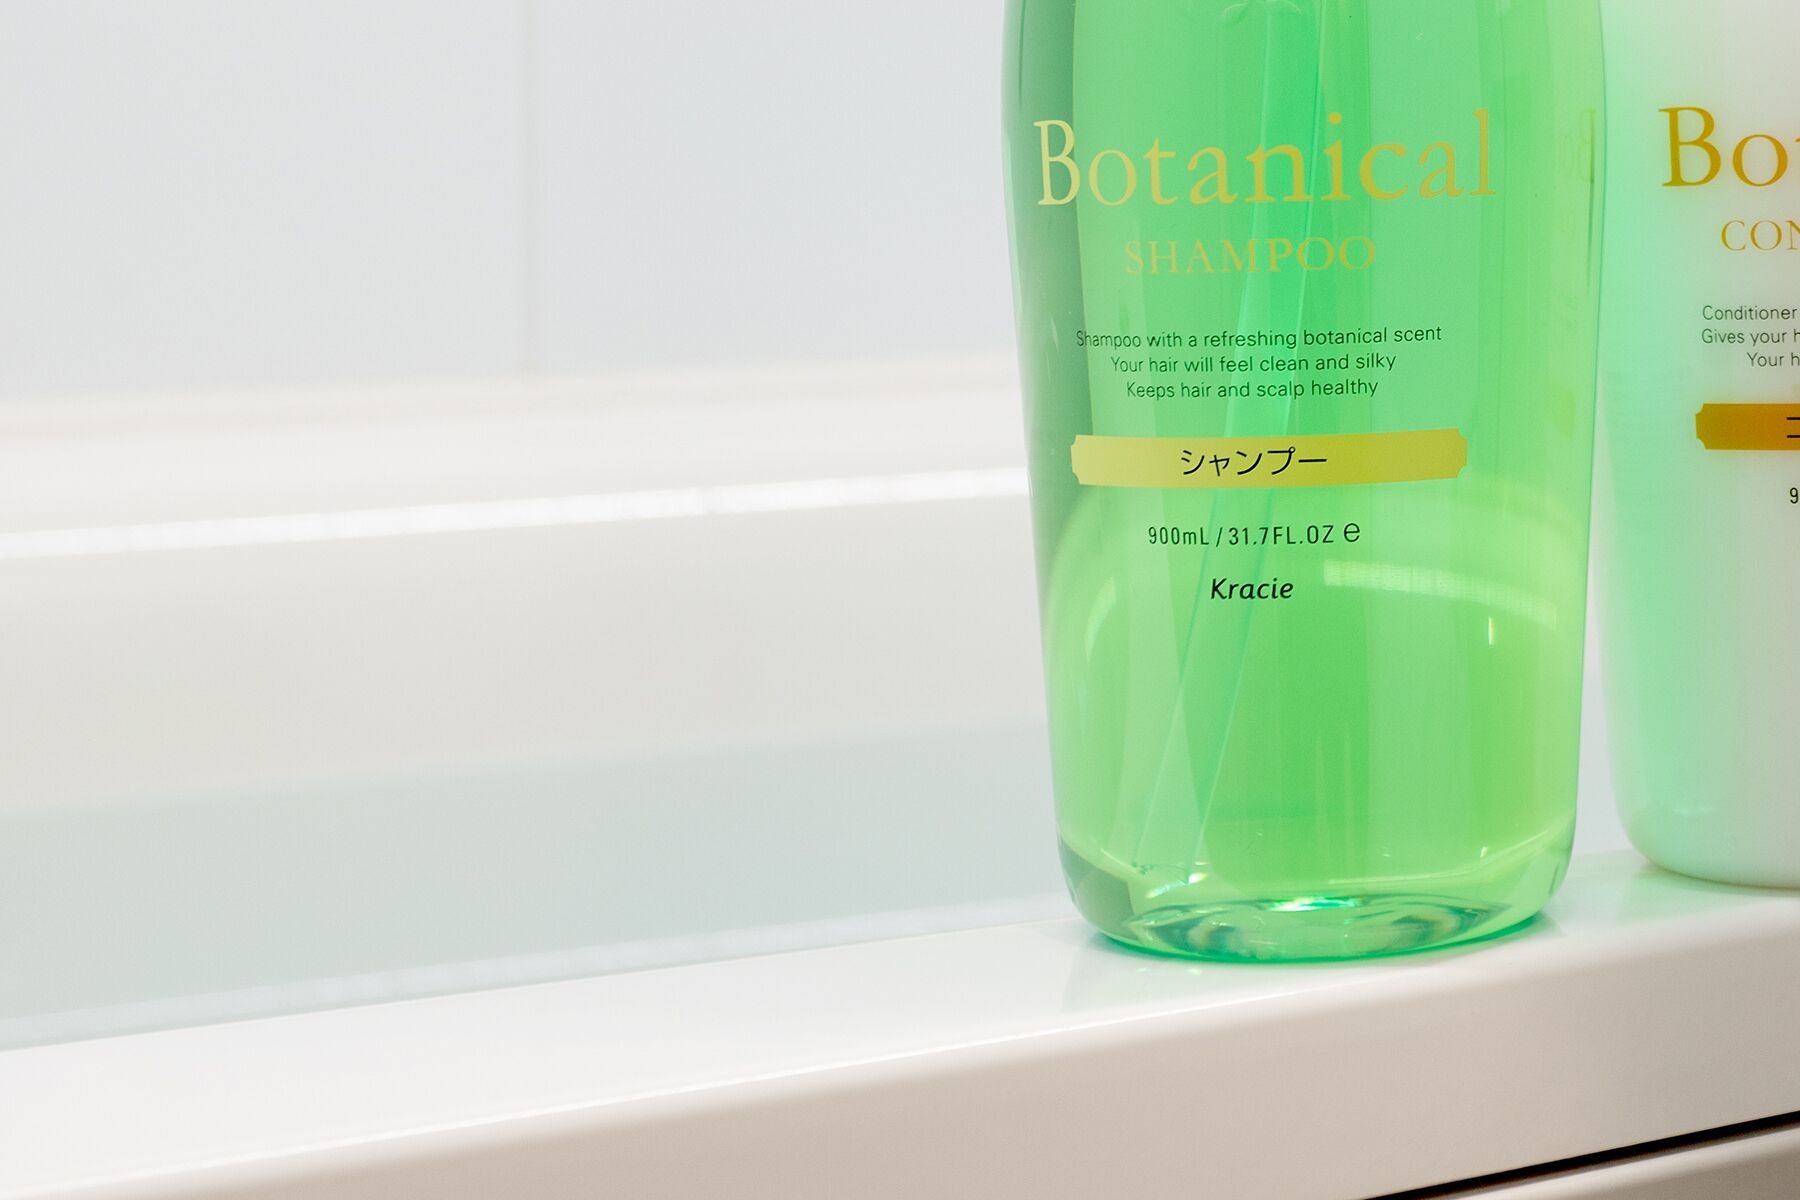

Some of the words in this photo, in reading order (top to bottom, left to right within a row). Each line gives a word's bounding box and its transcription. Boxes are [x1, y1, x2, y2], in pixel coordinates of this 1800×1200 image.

[1033, 107, 1496, 206] Botanical
[1125, 235, 1375, 275] SHAMPOO
[1702, 305, 1797, 321] Conditioner
[1076, 330, 1141, 348] Shampoo
[1147, 330, 1182, 346] with
[1188, 334, 1197, 346] a
[1204, 329, 1297, 349] refreshing
[1303, 327, 1387, 346] botanical
[1394, 326, 1442, 342] scent
[1702, 328, 1744, 345] Gives
[1751, 331, 1786, 346] your
[1111, 356, 1143, 373] Your
[1149, 356, 1177, 372] hair
[1184, 355, 1213, 372] will
[1220, 355, 1253, 371] feel
[1260, 355, 1308, 371] clean
[1315, 353, 1349, 370] and
[1355, 353, 1396, 371] silky
[1747, 352, 1783, 367] Your
[1127, 381, 1175, 400] Keeps
[1181, 381, 1211, 397] hair
[1217, 381, 1250, 397] and
[1257, 381, 1305, 399] scalp
[1311, 379, 1378, 397] healthy
[1180, 446, 1327, 477] シャンプー
[1210, 577, 1293, 599] Kracie
